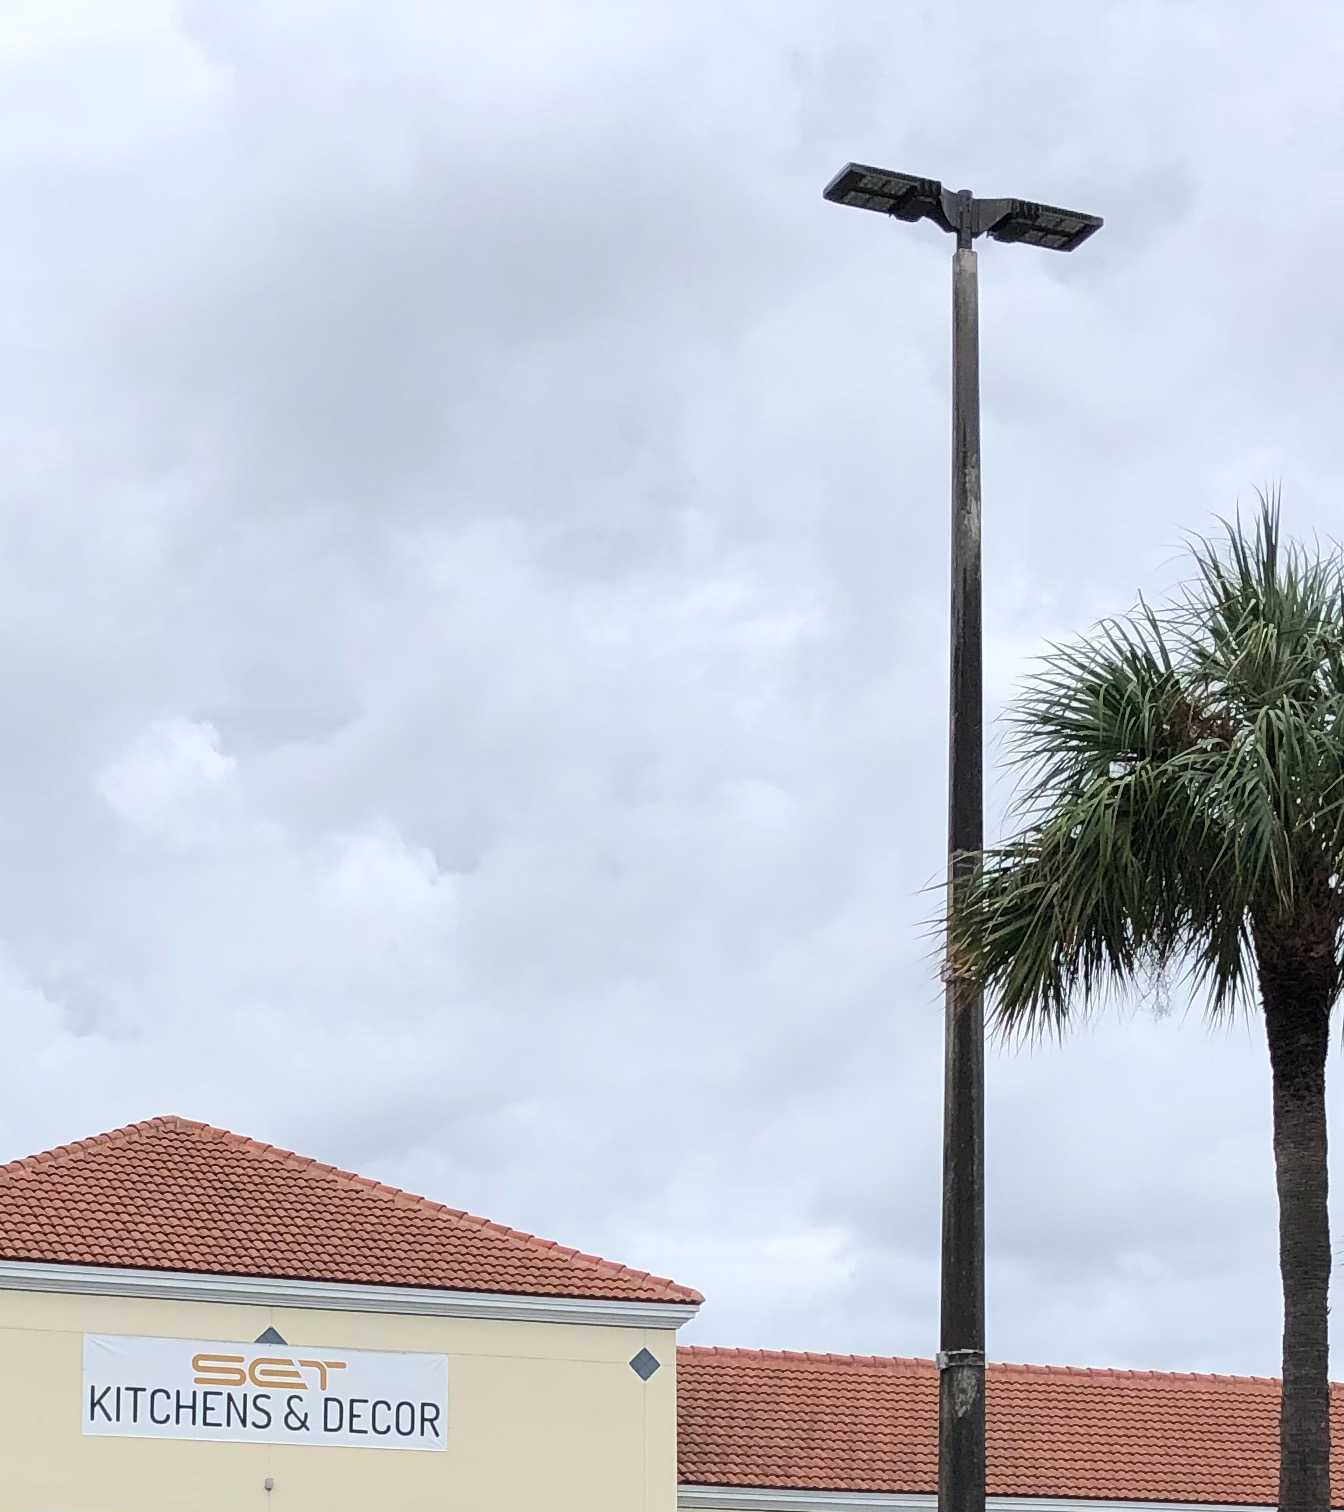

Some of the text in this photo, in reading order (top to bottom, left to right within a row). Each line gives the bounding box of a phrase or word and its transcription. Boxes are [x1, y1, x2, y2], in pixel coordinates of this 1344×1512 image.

[192, 1353, 347, 1391] SET
[89, 1384, 441, 1438] KITCHENS & DECOR
